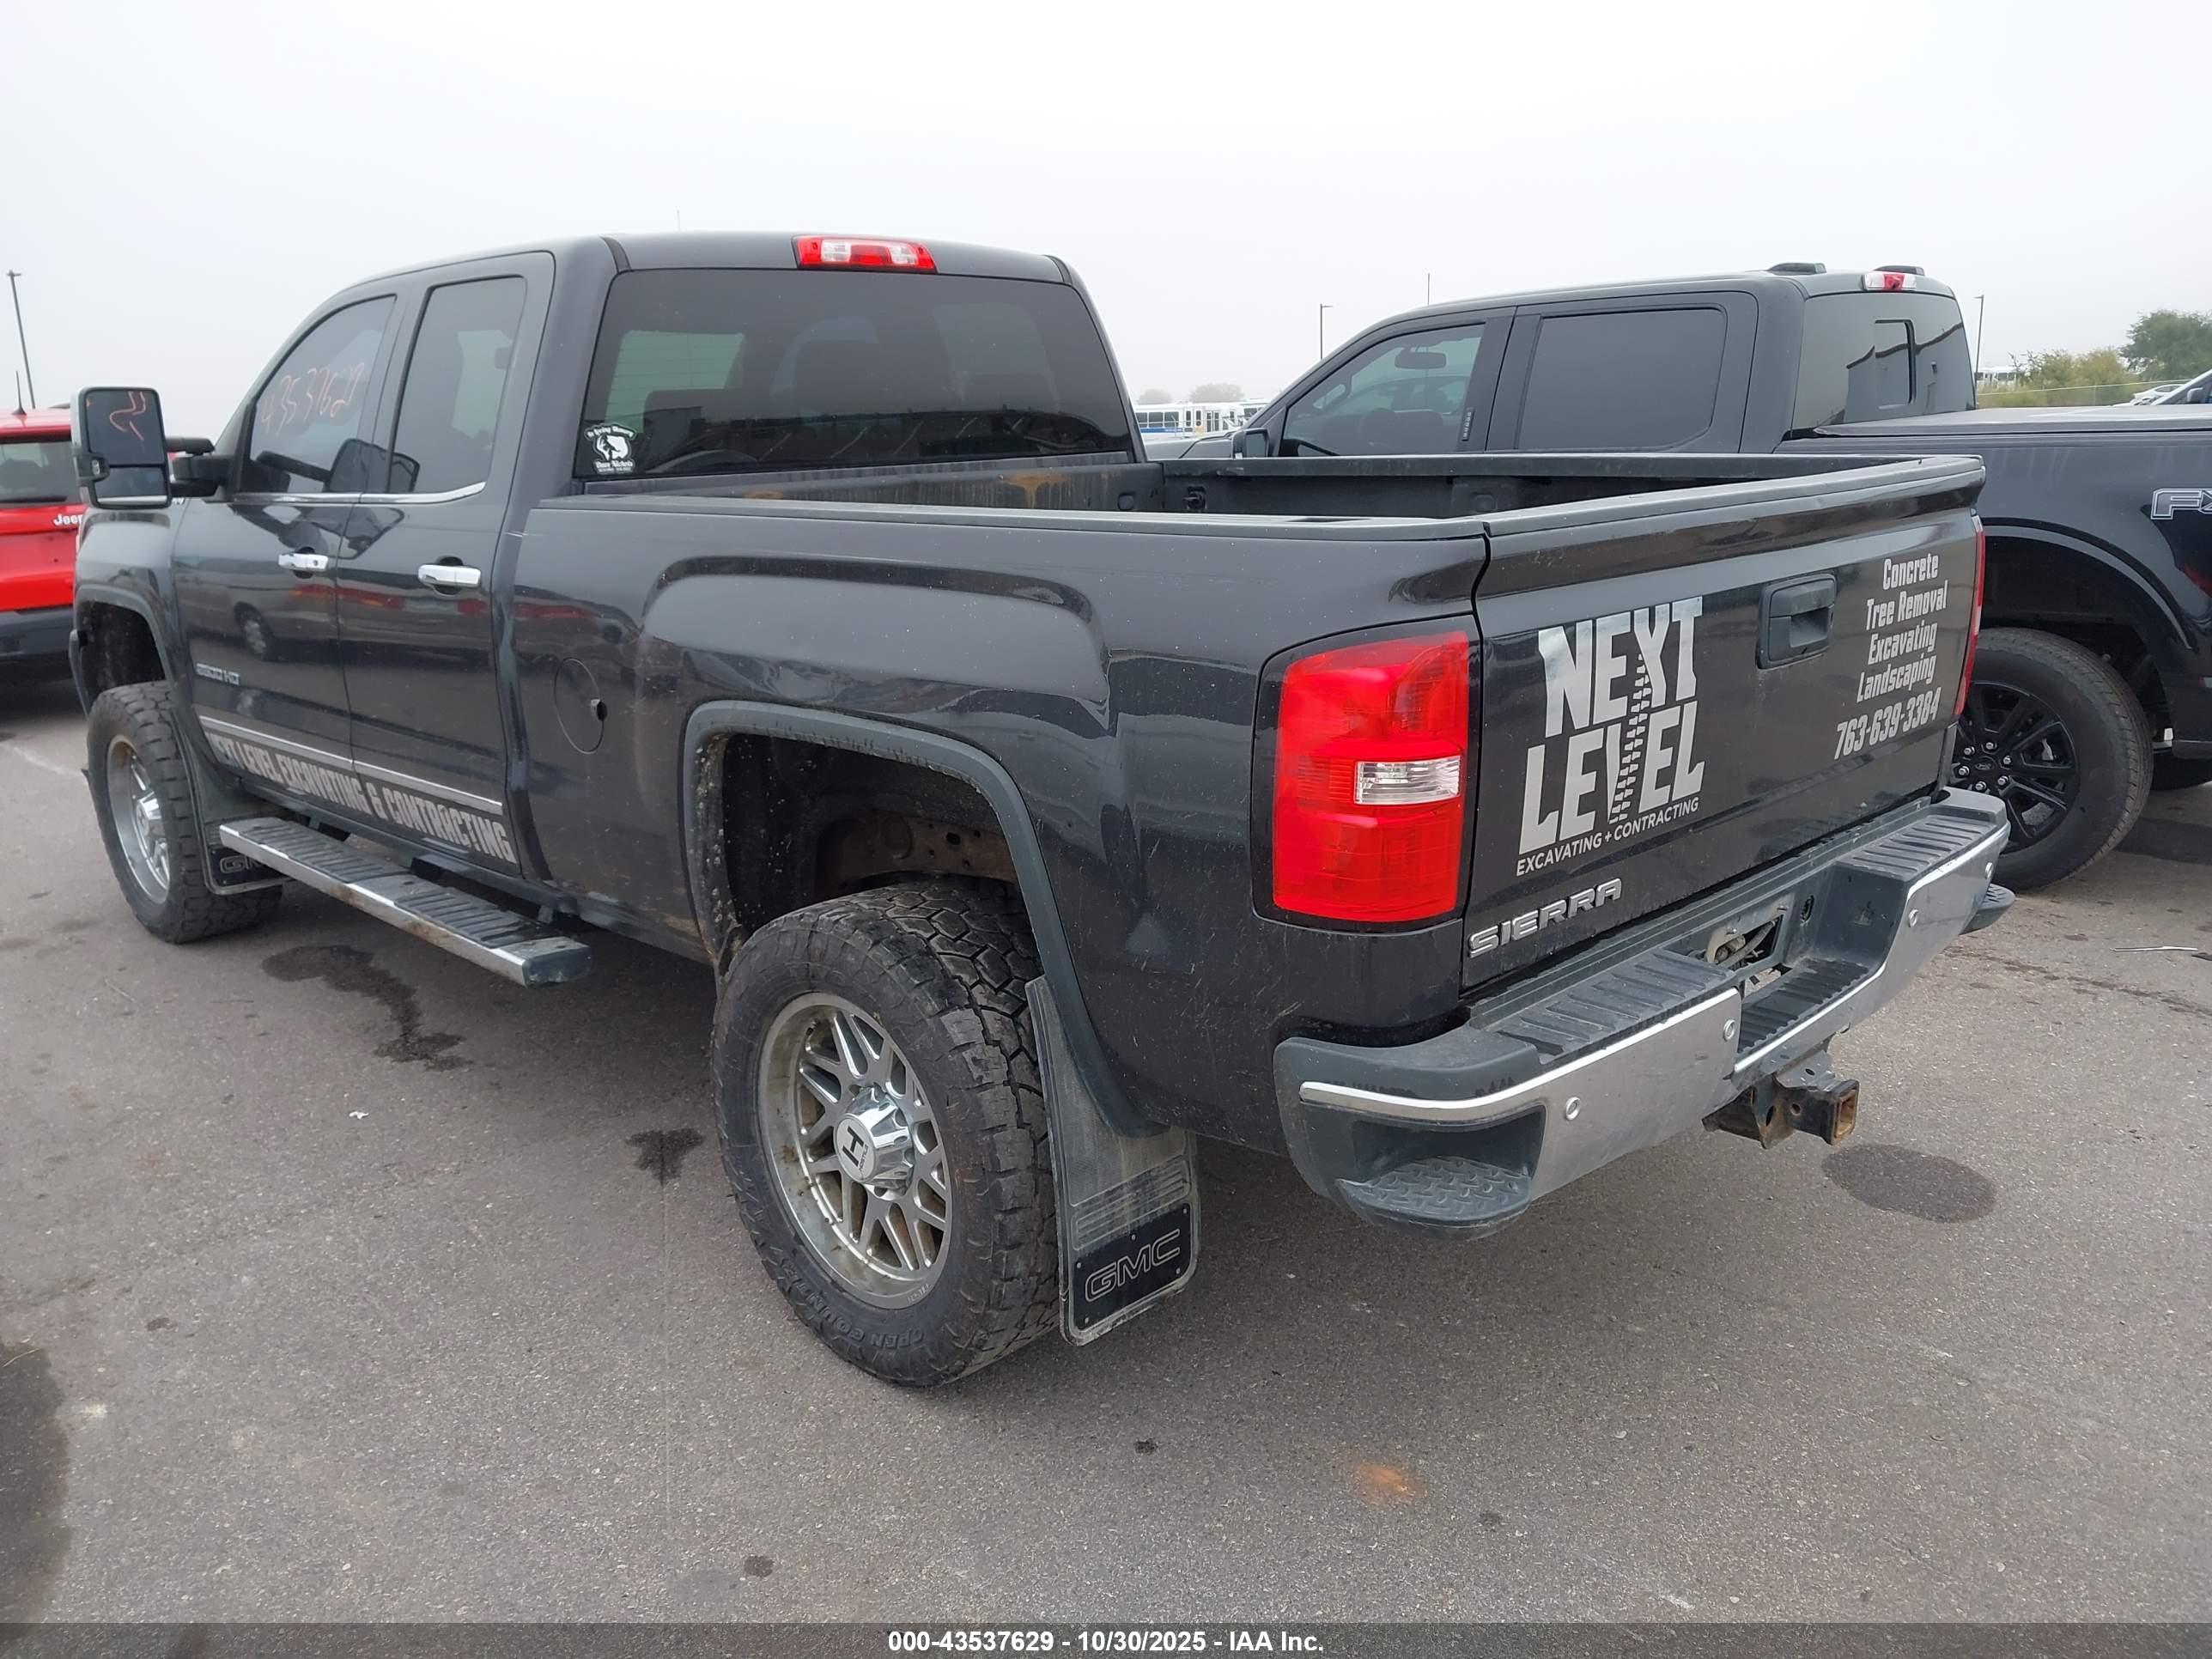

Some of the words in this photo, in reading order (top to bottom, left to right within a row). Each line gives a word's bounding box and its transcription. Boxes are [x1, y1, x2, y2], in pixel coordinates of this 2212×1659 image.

[2150, 488, 2212, 520] F
[1866, 598, 1895, 630] Tree
[1897, 580, 1948, 623] Removal
[1882, 552, 1939, 591] Concrete
[1538, 596, 1703, 738] NEXT
[1856, 653, 1937, 703] Landscaping
[1868, 619, 1938, 665] Excavating
[1834, 687, 1942, 760] 763-639-3384
[235, 740, 284, 784] LEVEL
[275, 753, 372, 815] EXCAVATING
[382, 787, 517, 865] CONTRACTING
[1519, 700, 1705, 855] LEVEL
[1516, 831, 1602, 877] EXCAVATING
[1613, 797, 1699, 842] CONTRACTING
[1469, 878, 1622, 958] SIERRA
[1085, 1228, 1181, 1303] GMC
